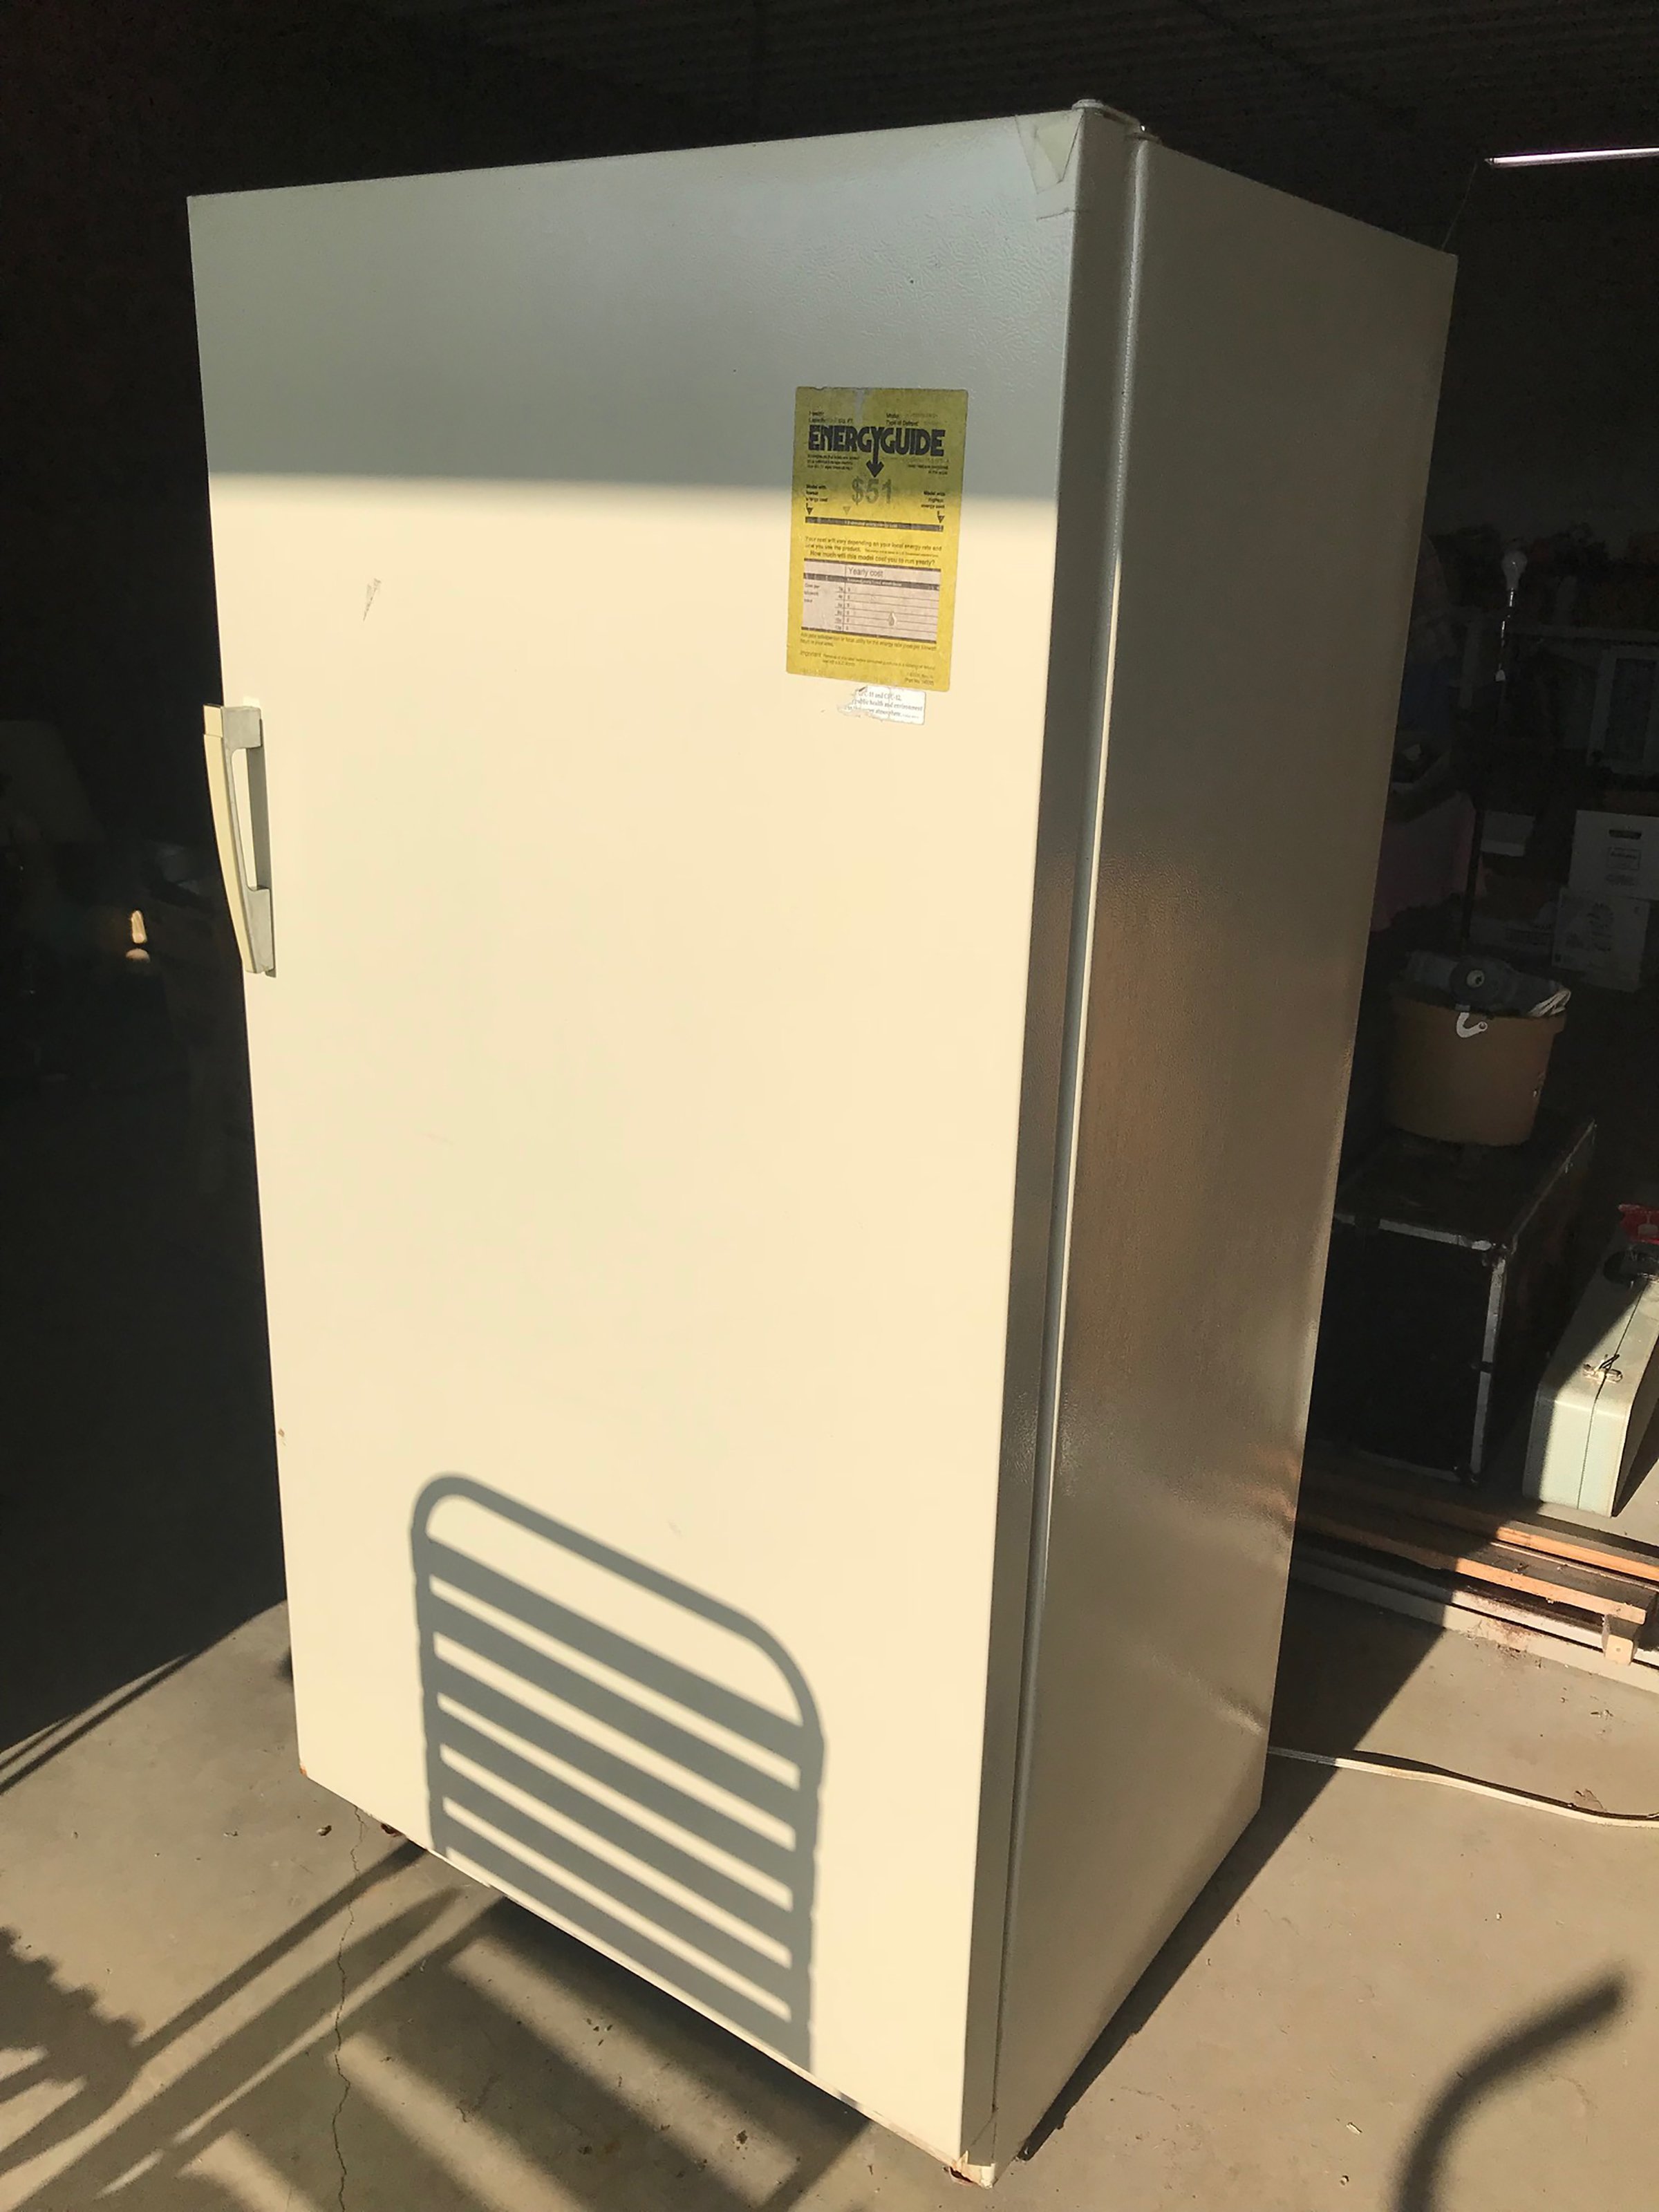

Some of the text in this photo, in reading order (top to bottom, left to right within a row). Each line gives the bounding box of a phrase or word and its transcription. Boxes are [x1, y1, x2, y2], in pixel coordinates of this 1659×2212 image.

[808, 424, 946, 458] ENERGYGUIDE
[851, 476, 892, 505] $51
[848, 566, 884, 578] Yearly cost
